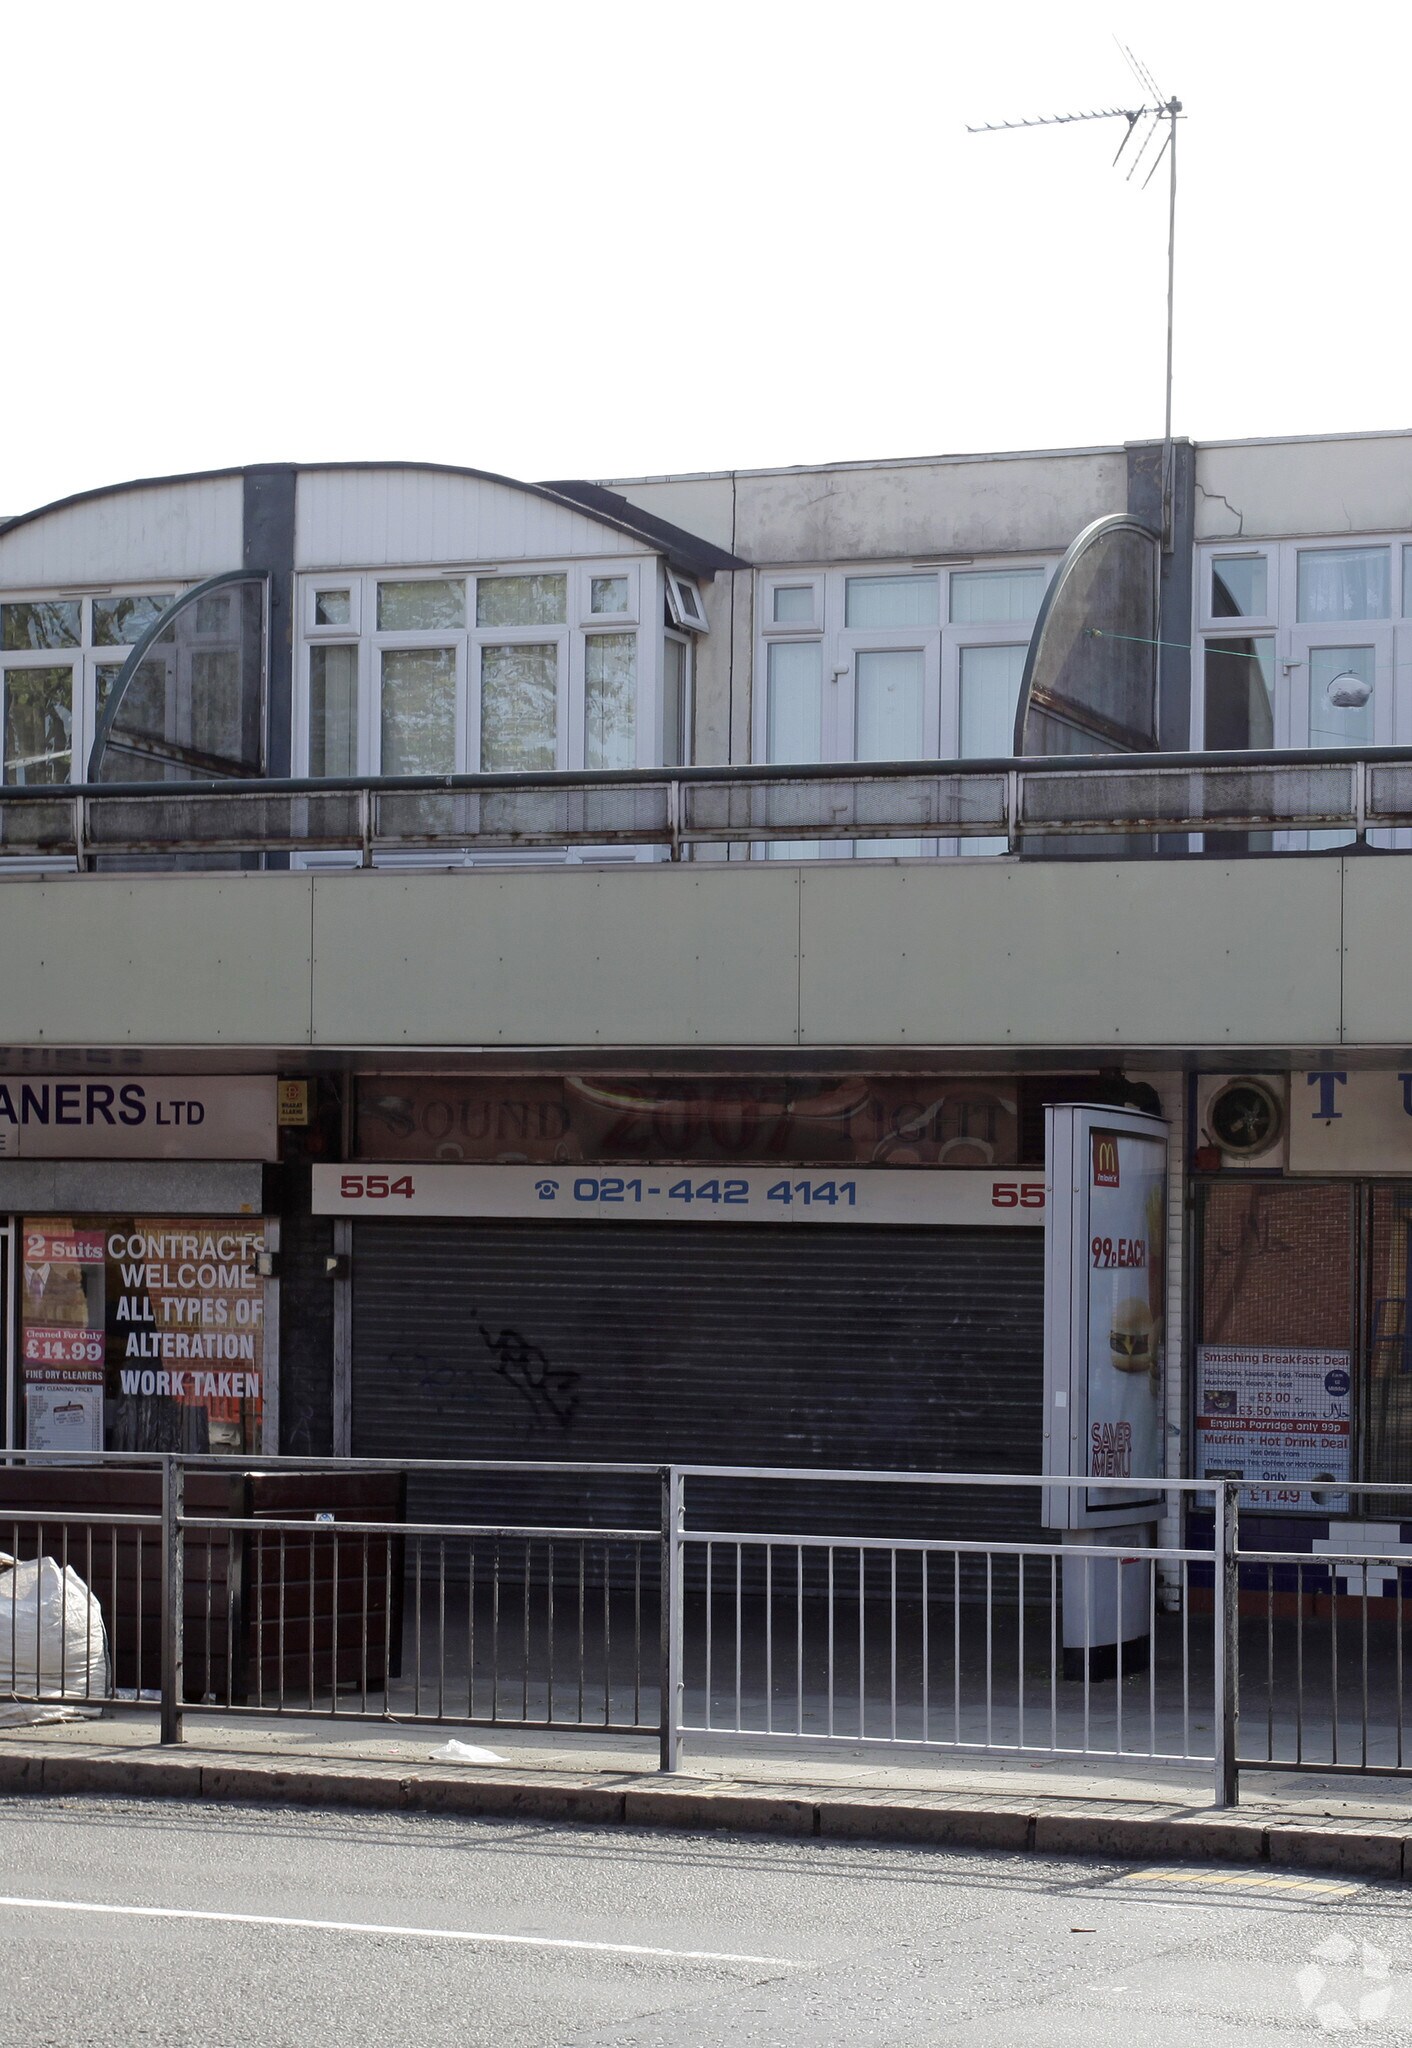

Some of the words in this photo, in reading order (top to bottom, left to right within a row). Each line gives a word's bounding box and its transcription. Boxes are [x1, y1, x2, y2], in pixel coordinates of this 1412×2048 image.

[156, 1101, 205, 1125] LTD
[340, 1175, 415, 1199] 554
[767, 1181, 856, 1205] 4141
[27, 1234, 46, 1257] 2
[51, 1241, 103, 1258] Suits
[1091, 1237, 1116, 1268] 99p
[1118, 1238, 1146, 1267] EACH
[120, 1264, 257, 1289] WELCOME
[116, 1296, 154, 1321] ALL
[161, 1297, 227, 1324] TYPES
[235, 1299, 263, 1324] OF
[26, 1331, 61, 1339] Cleaned
[63, 1331, 77, 1339] For
[78, 1331, 102, 1341] Only
[125, 1332, 254, 1359] ALTERATION
[26, 1338, 102, 1360] £14.99
[1204, 1352, 1259, 1365] Smashing
[1262, 1354, 1320, 1366] Breakfast
[1324, 1355, 1349, 1366] Deal
[25, 1370, 43, 1379] FINE
[45, 1371, 60, 1379] DRY
[62, 1371, 103, 1380] CLEANERS
[120, 1370, 185, 1397] WORK
[191, 1372, 259, 1398] TAKEN
[1257, 1392, 1291, 1403] £3.00
[1239, 1405, 1271, 1416] £3.50
[1091, 1422, 1132, 1453] SAVER
[1210, 1419, 1246, 1430] English
[1249, 1421, 1293, 1431] Porridge
[1296, 1422, 1318, 1432] only
[1321, 1423, 1341, 1433] 99p
[1204, 1434, 1244, 1445] Muffin
[1259, 1436, 1280, 1447] Hot
[1285, 1437, 1317, 1448] Drink
[1321, 1438, 1348, 1449] Deal
[1092, 1451, 1131, 1478] MENU
